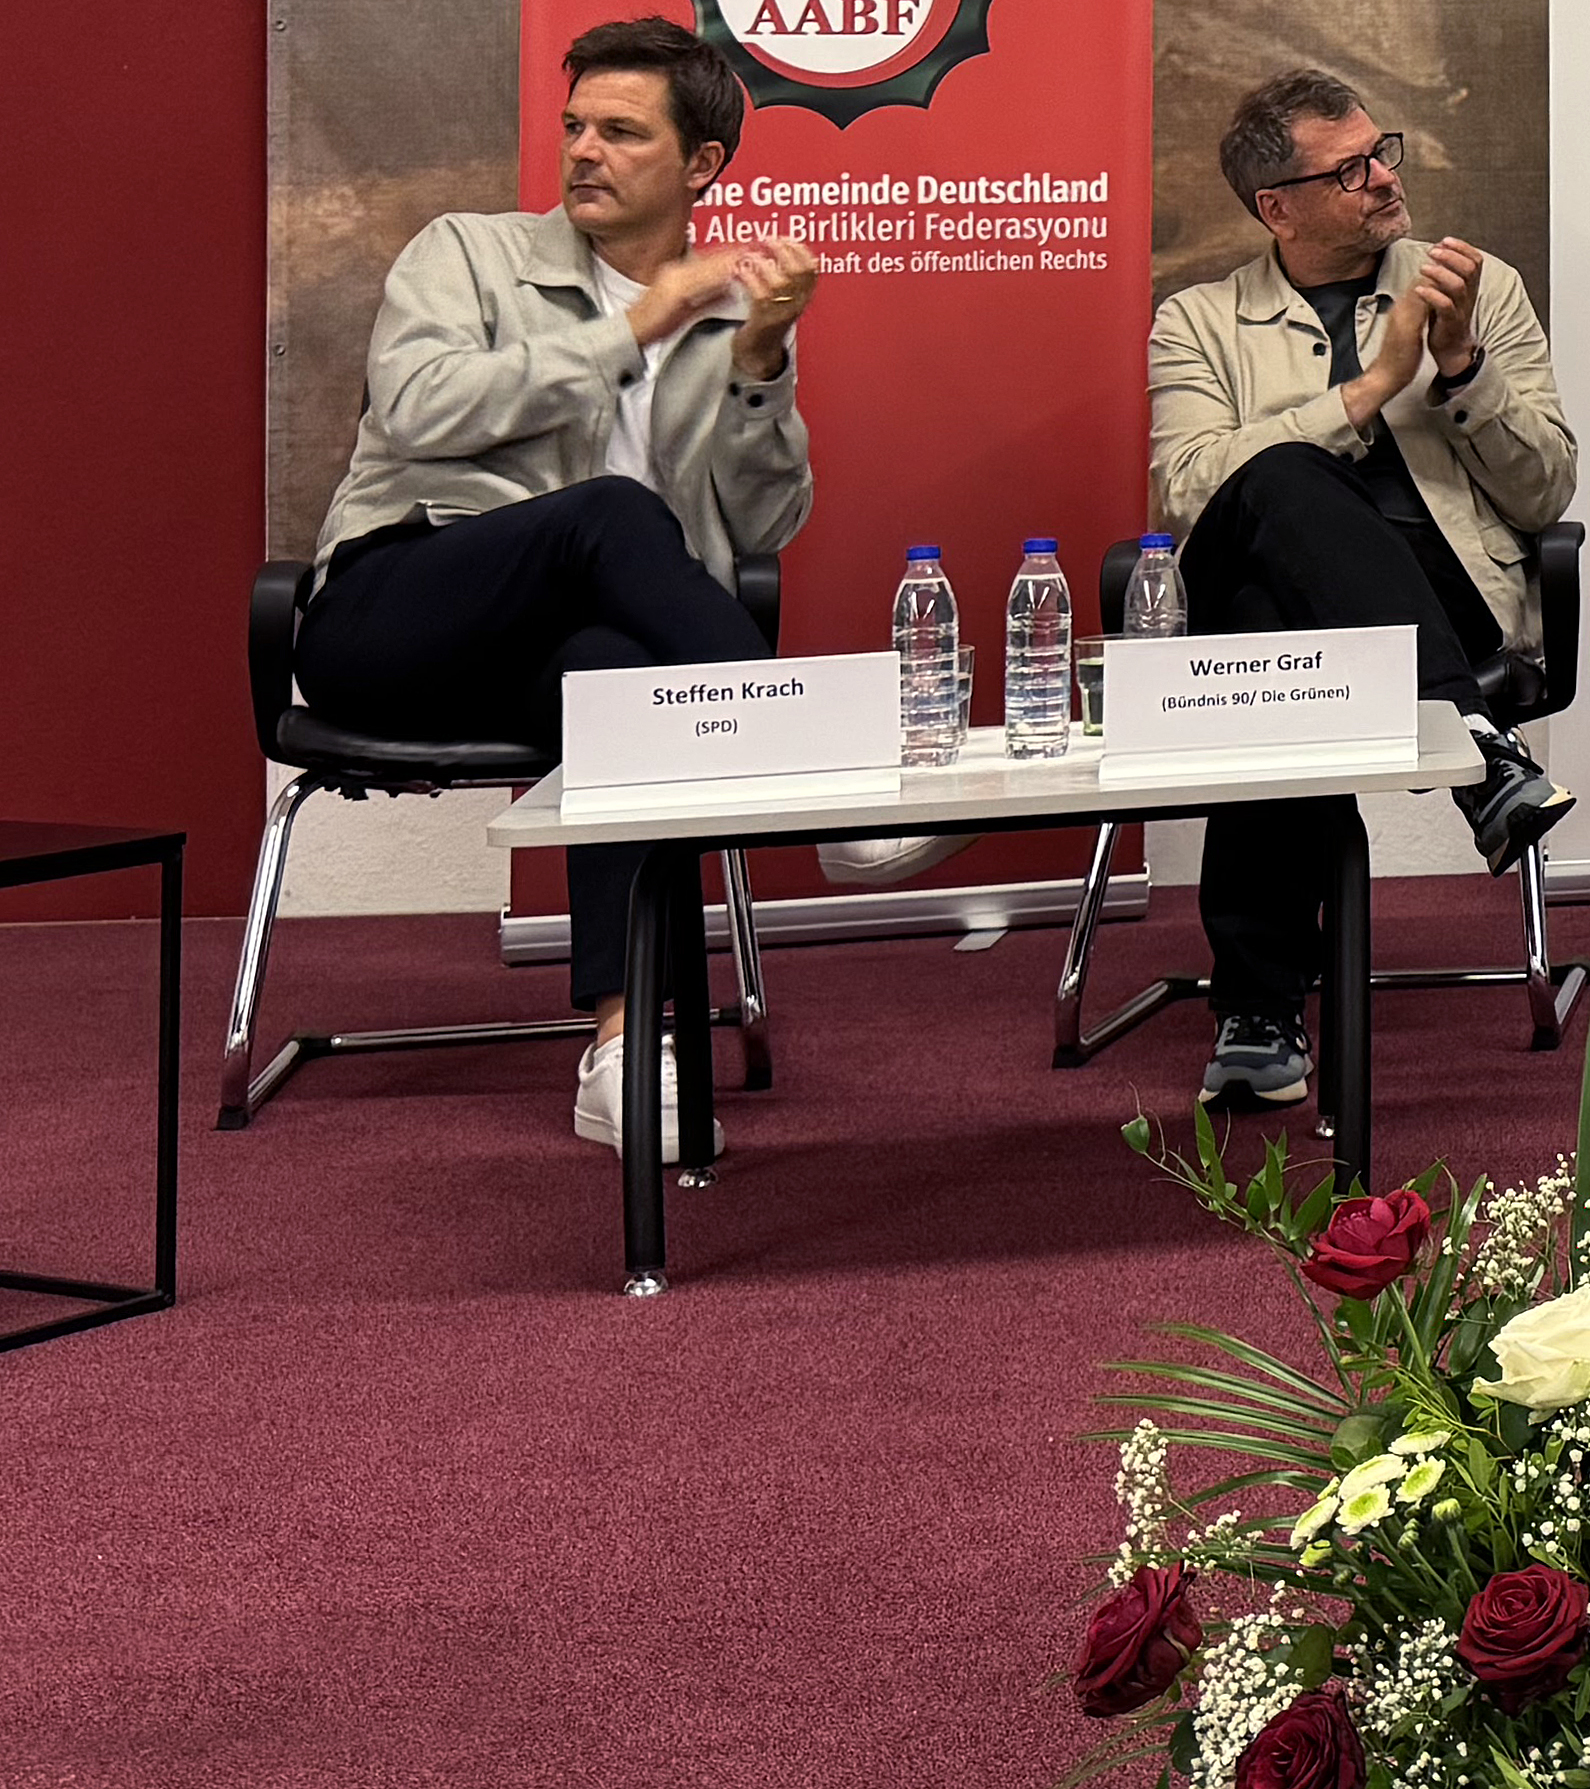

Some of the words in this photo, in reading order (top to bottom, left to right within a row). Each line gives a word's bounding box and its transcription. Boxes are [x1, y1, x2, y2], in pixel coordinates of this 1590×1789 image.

[751, 173, 909, 206] Gemeinde
[918, 172, 1107, 204] Deutschland
[705, 211, 779, 243] Alevi
[790, 211, 915, 244] Birlikleri
[926, 211, 1106, 245] Federasyonu
[868, 252, 904, 273] des
[911, 250, 1033, 272] öffentlichen
[1041, 249, 1107, 269] Rechts
[1190, 659, 1270, 676] Werner
[1277, 651, 1322, 670] Graf
[653, 684, 733, 705] Steffen
[742, 678, 803, 699] Krach
[1162, 694, 1227, 712] (Bündnis
[1232, 690, 1256, 706] 90/
[1262, 690, 1285, 702] Die
[1290, 686, 1349, 700] Grünen)
[696, 719, 737, 737] (SPD)
